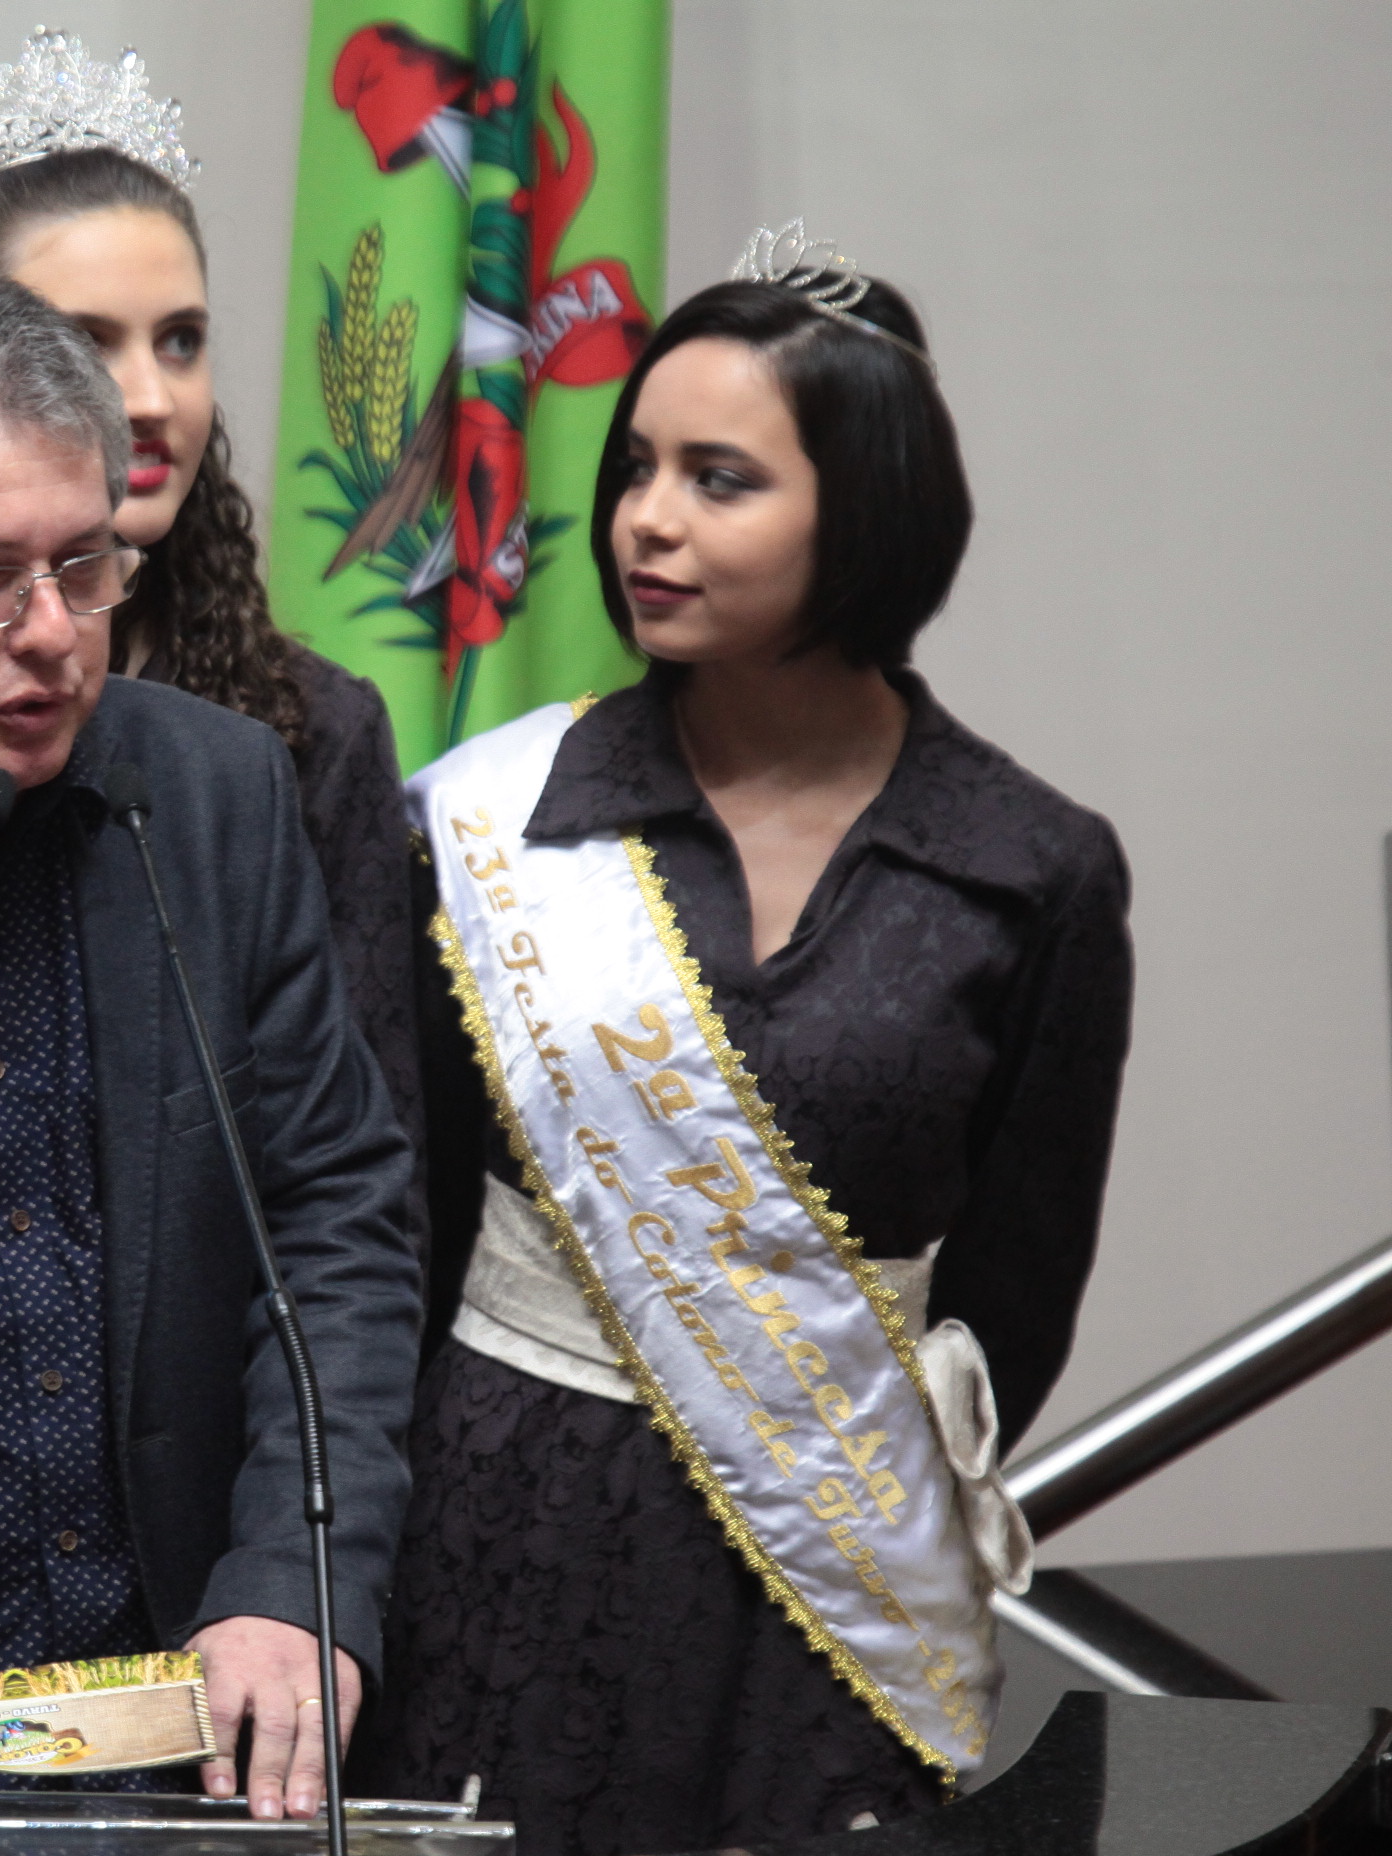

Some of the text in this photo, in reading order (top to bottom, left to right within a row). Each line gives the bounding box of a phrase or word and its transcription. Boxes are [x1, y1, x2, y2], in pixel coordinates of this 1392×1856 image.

[576, 1126, 634, 1204] do
[628, 1211, 761, 1401] Colono
[749, 1410, 798, 1479] de
[665, 1137, 907, 1525] Princesa
[11, 1704, 62, 1718] TURVO
